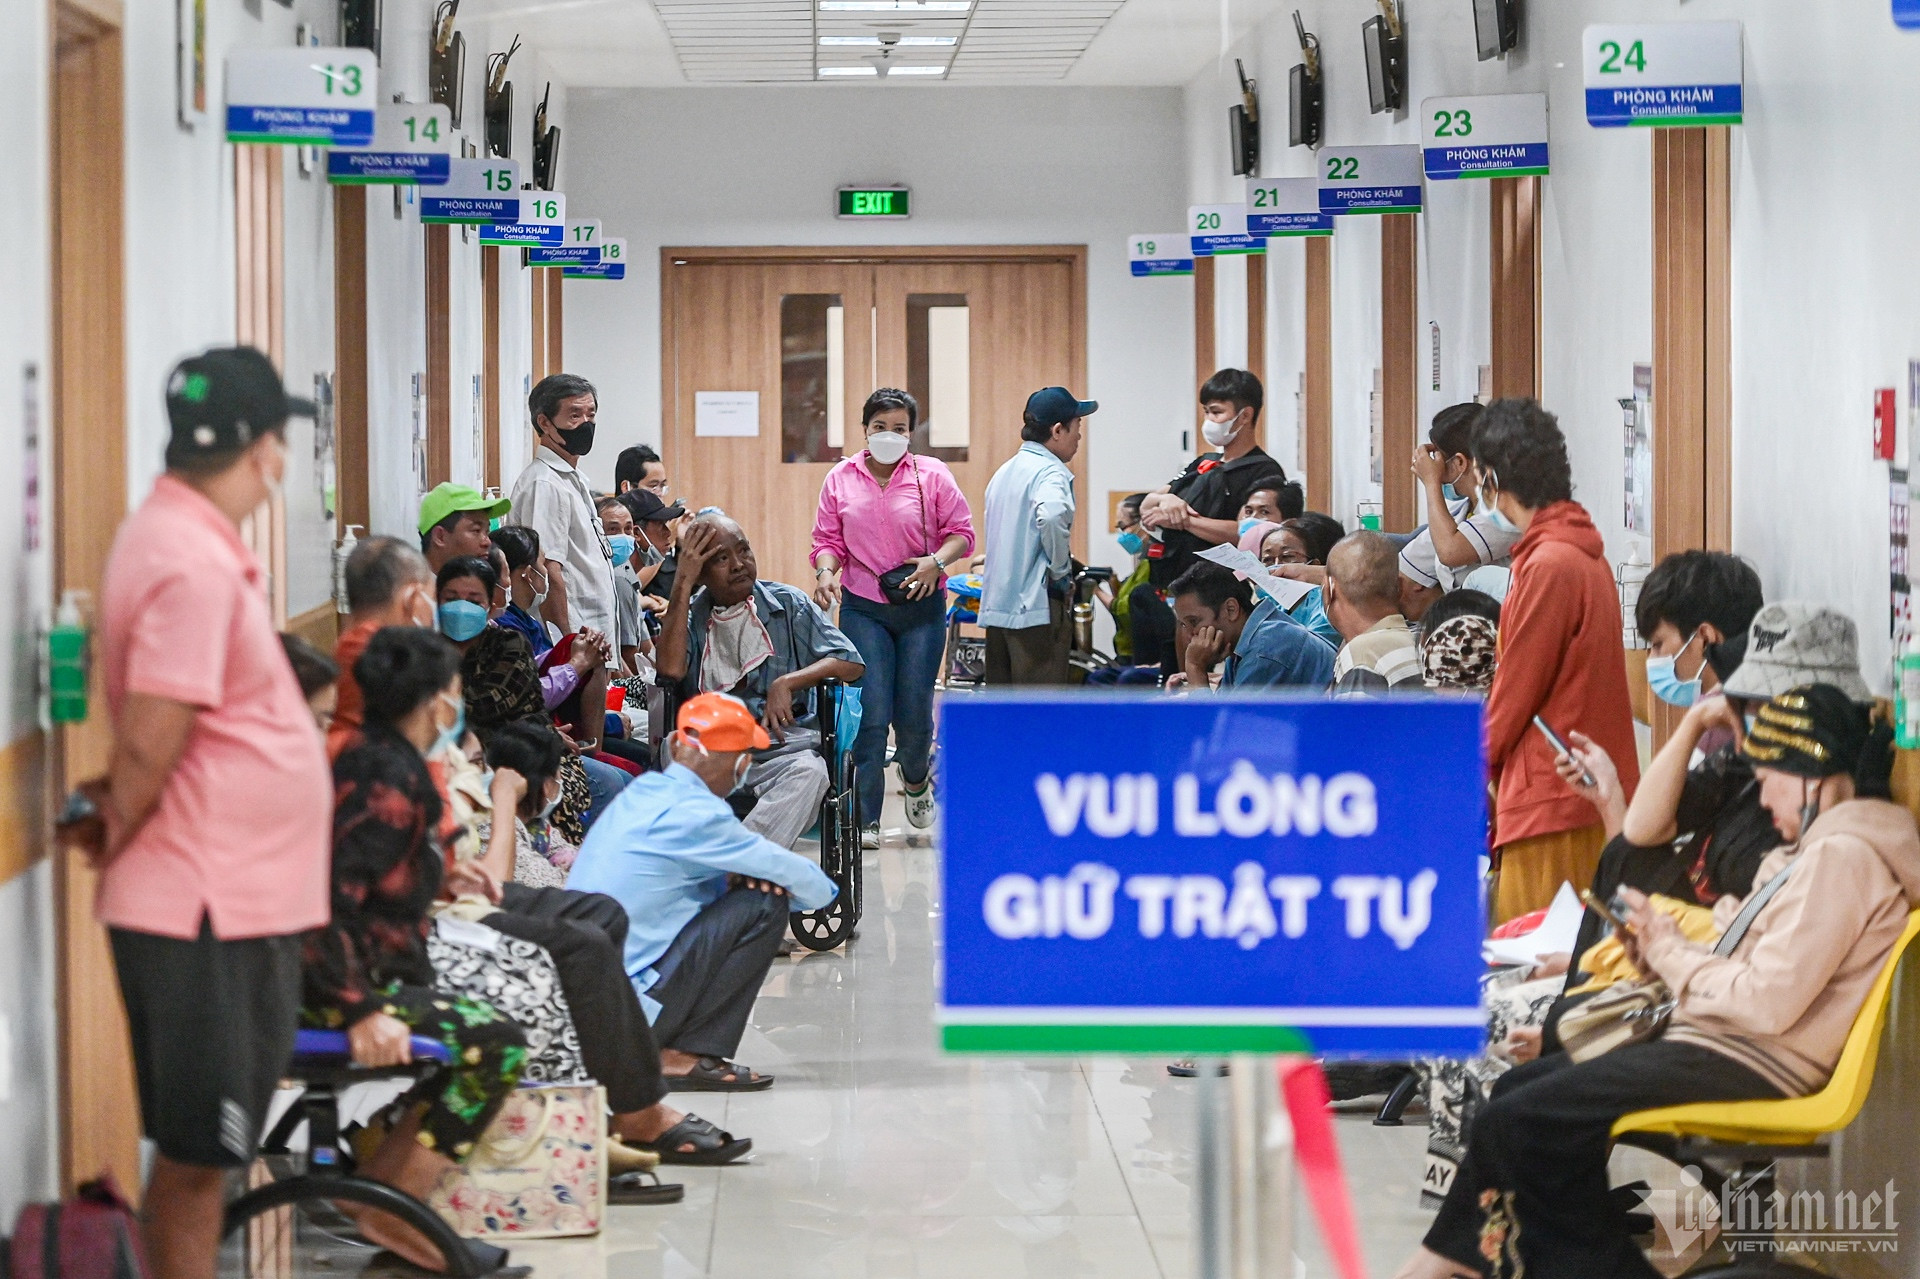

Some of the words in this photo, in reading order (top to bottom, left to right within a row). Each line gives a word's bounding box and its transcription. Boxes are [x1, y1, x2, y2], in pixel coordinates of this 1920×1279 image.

[1599, 39, 1647, 73] 24
[324, 64, 362, 96] 13
[1613, 89, 1666, 104] PHÒNG
[1670, 87, 1714, 103] KHÁM
[1631, 104, 1697, 116] Consultation
[403, 116, 440, 143] 14
[1434, 109, 1473, 137] 23
[1446, 148, 1488, 161] PHÒNG
[1491, 146, 1526, 158] KHÁM
[1327, 157, 1359, 179] 22
[1460, 160, 1513, 169] Consultation
[482, 169, 512, 192] 15
[1253, 188, 1278, 207] 21
[1336, 189, 1372, 199] PHÒNG
[1374, 189, 1403, 198] KHÁM
[439, 199, 473, 209] PHÒNG
[475, 201, 503, 210] KHÁM
[532, 199, 558, 218] 16
[852, 192, 894, 214] EXIT
[1347, 199, 1393, 207] Consultation
[494, 224, 524, 233] PHÒNG
[525, 225, 550, 235] KHÁM
[1197, 213, 1221, 230] 20
[503, 233, 541, 241] Consultation
[573, 226, 595, 242] 17
[601, 244, 620, 258] 18
[1136, 241, 1156, 255] 19
[1034, 771, 1159, 837] VUI
[1172, 759, 1379, 838] LÒNG
[983, 862, 1120, 939] GIỮ
[1124, 861, 1322, 950] TRẬT
[1332, 867, 1438, 950] TỰ
